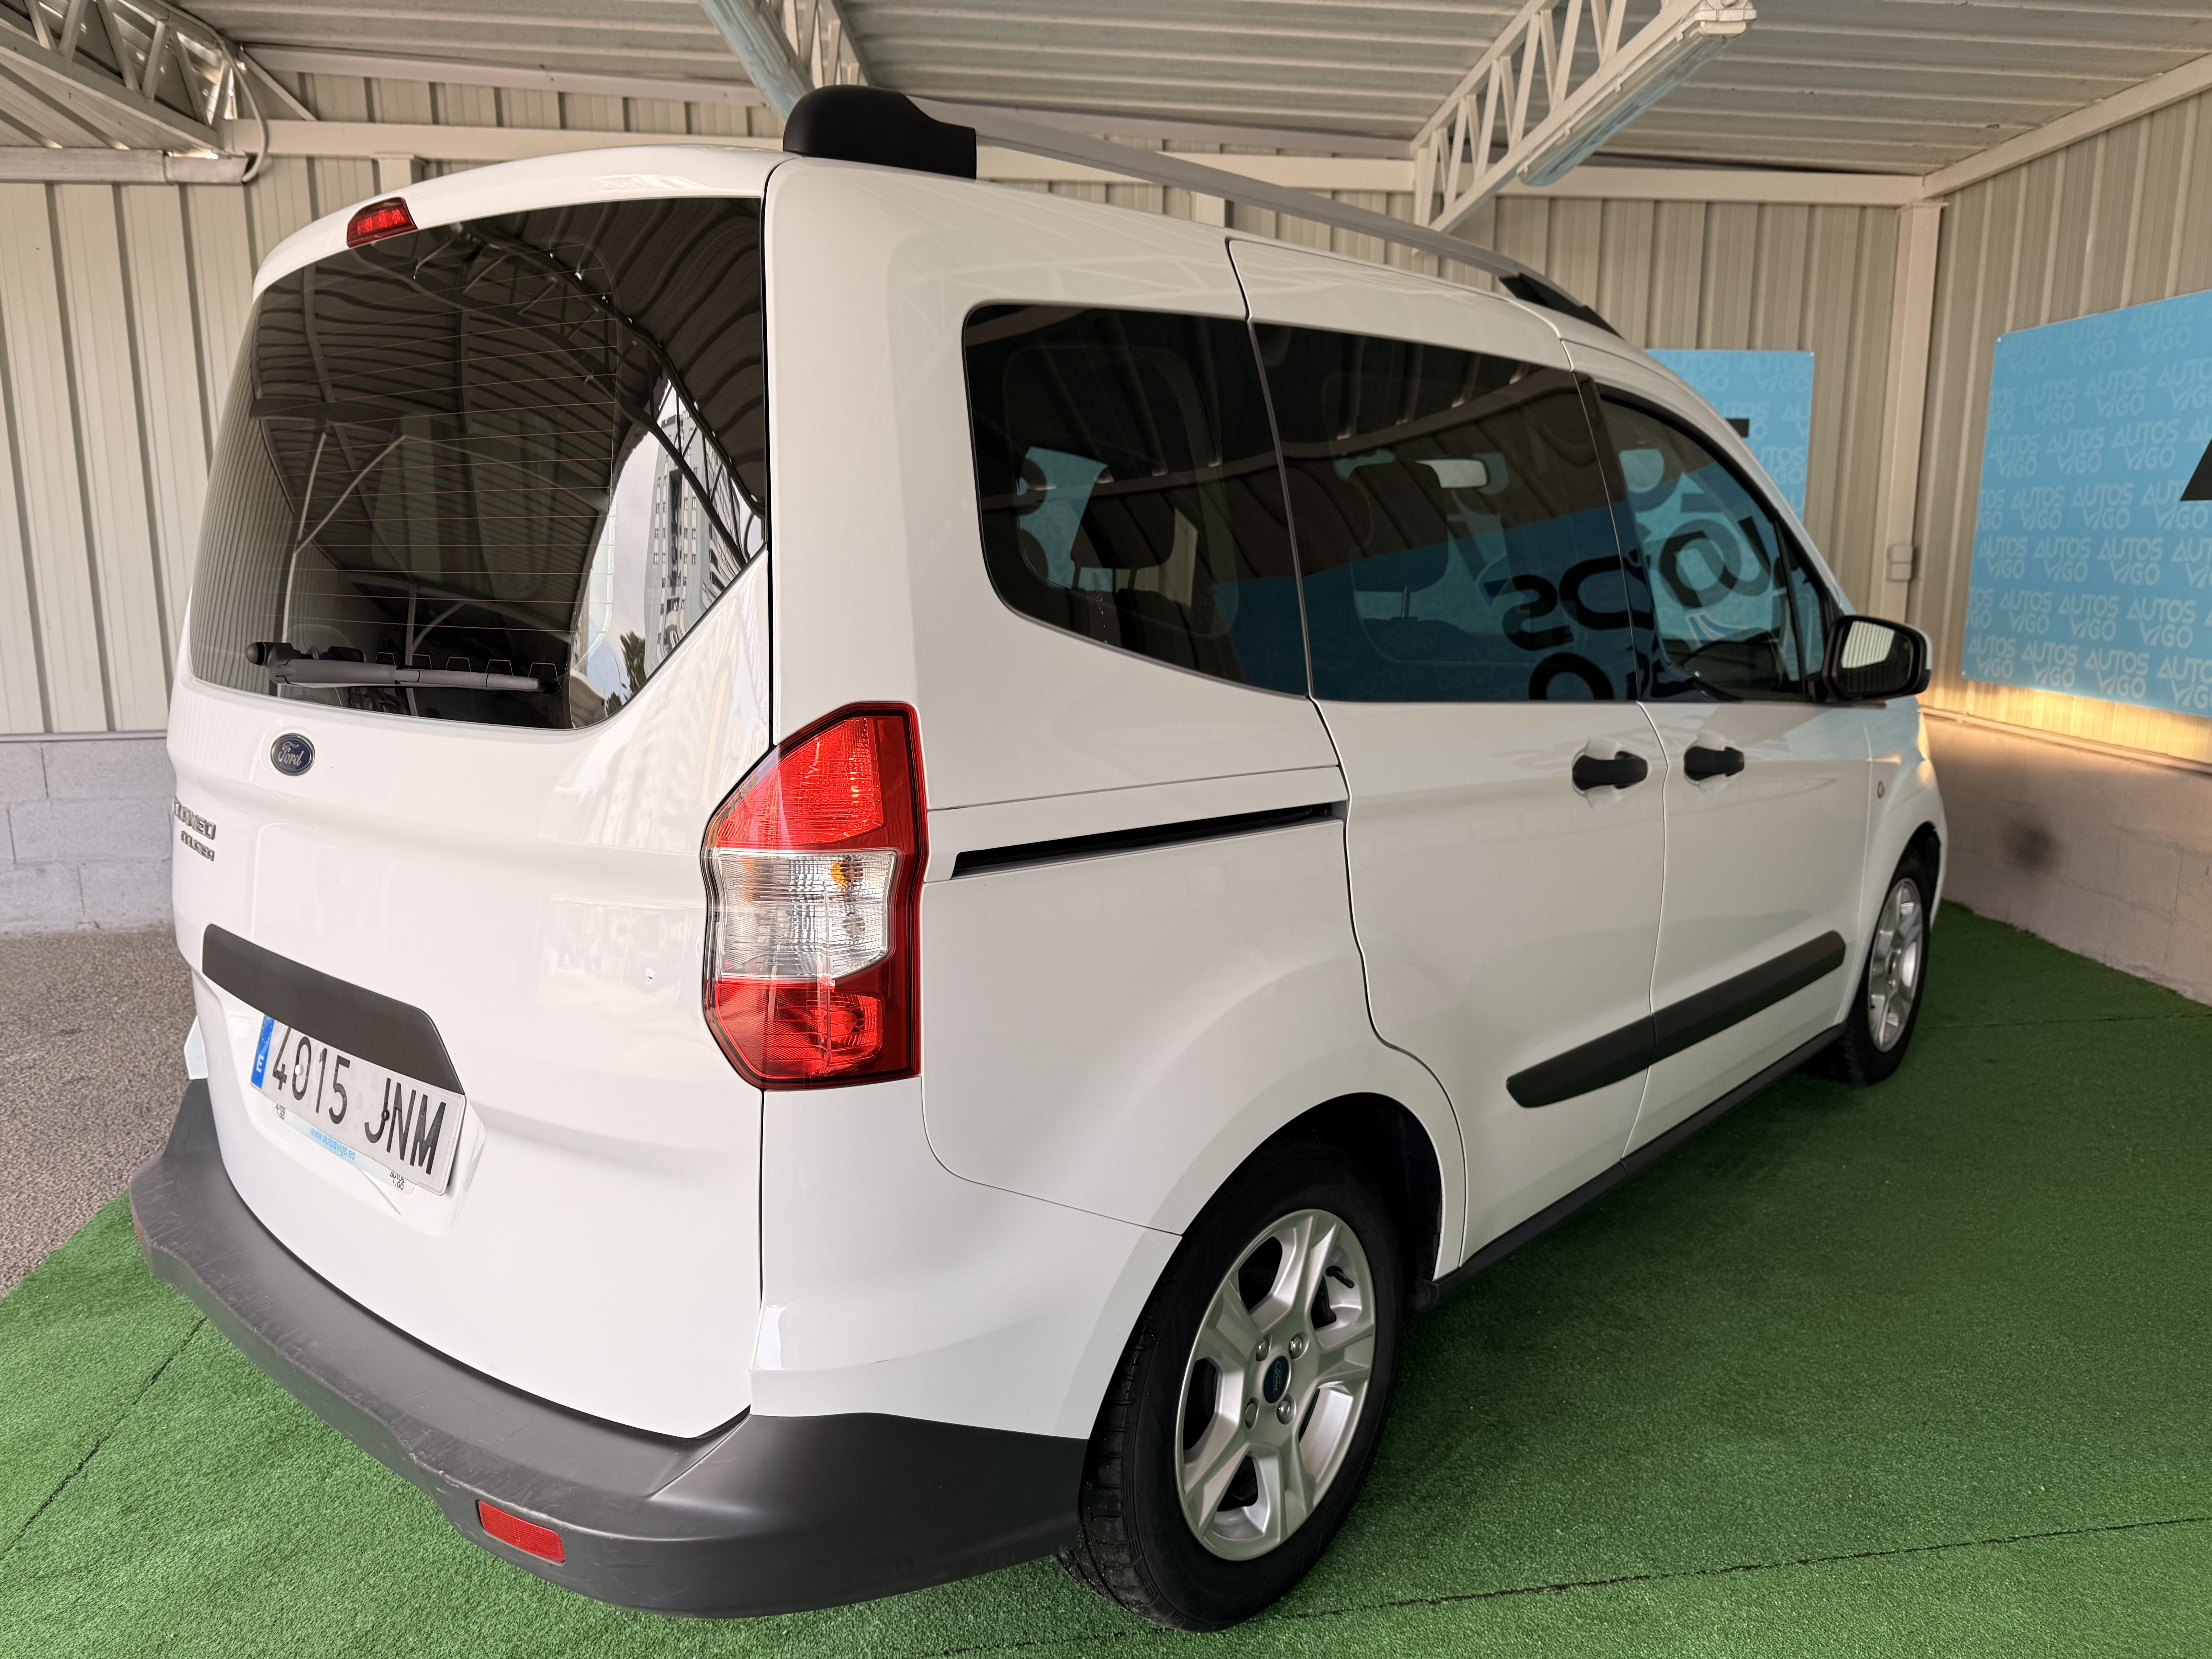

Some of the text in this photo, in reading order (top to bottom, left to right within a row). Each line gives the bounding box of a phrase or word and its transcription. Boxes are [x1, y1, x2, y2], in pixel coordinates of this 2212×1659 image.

[2140, 326, 2192, 354] VIGO
[2084, 367, 2149, 398] AUTOS
[2155, 357, 2212, 388] AUTO
[2021, 378, 2079, 407] AUTOS
[2096, 393, 2145, 418] VIGO
[2169, 385, 2212, 411] VIG
[2032, 402, 2075, 425] VIGO
[1989, 434, 2040, 459] AUTOS
[2046, 427, 2105, 453] AUTOS
[2111, 419, 2181, 448] AUTOS
[1997, 456, 2037, 478] VIGO
[2056, 450, 2102, 475] VIGO
[2124, 446, 2176, 471] VIGO
[2011, 486, 2065, 509] AUTOS
[2071, 483, 2134, 507] AUTOS
[2020, 507, 2063, 530] VIGO
[2082, 503, 2131, 530] VIGO
[2154, 503, 2209, 530] VIGO
[1978, 536, 2028, 558] AUTOS
[2033, 536, 2092, 559] AUTOS
[2097, 536, 2165, 562] AUTOS
[1986, 557, 2025, 580] VIGO
[2044, 559, 2088, 582] VIGO
[2110, 560, 2160, 586] VIGO
[1999, 589, 2053, 611] AUTOS
[2058, 592, 2120, 618] AUTOS
[2126, 596, 2197, 624] AUTOS
[2009, 611, 2050, 634] VIGO
[2069, 616, 2116, 641] VIGO
[2140, 620, 2193, 649] VIGO
[1967, 634, 2016, 657] AUTOS
[2022, 641, 2078, 666] AUTOS
[1975, 654, 2013, 678] VIGO
[2032, 660, 2075, 687] VIGO
[2084, 648, 2149, 677] AUTOS
[2156, 656, 2212, 684] AUTO
[2095, 670, 2145, 698] VIGO
[2171, 679, 2212, 708] VIG
[278, 741, 304, 767] Ford
[256, 1054, 264, 1073] E
[272, 1027, 446, 1175] 4015 JNM
[310, 1127, 355, 1160] www.autosvigo.es
